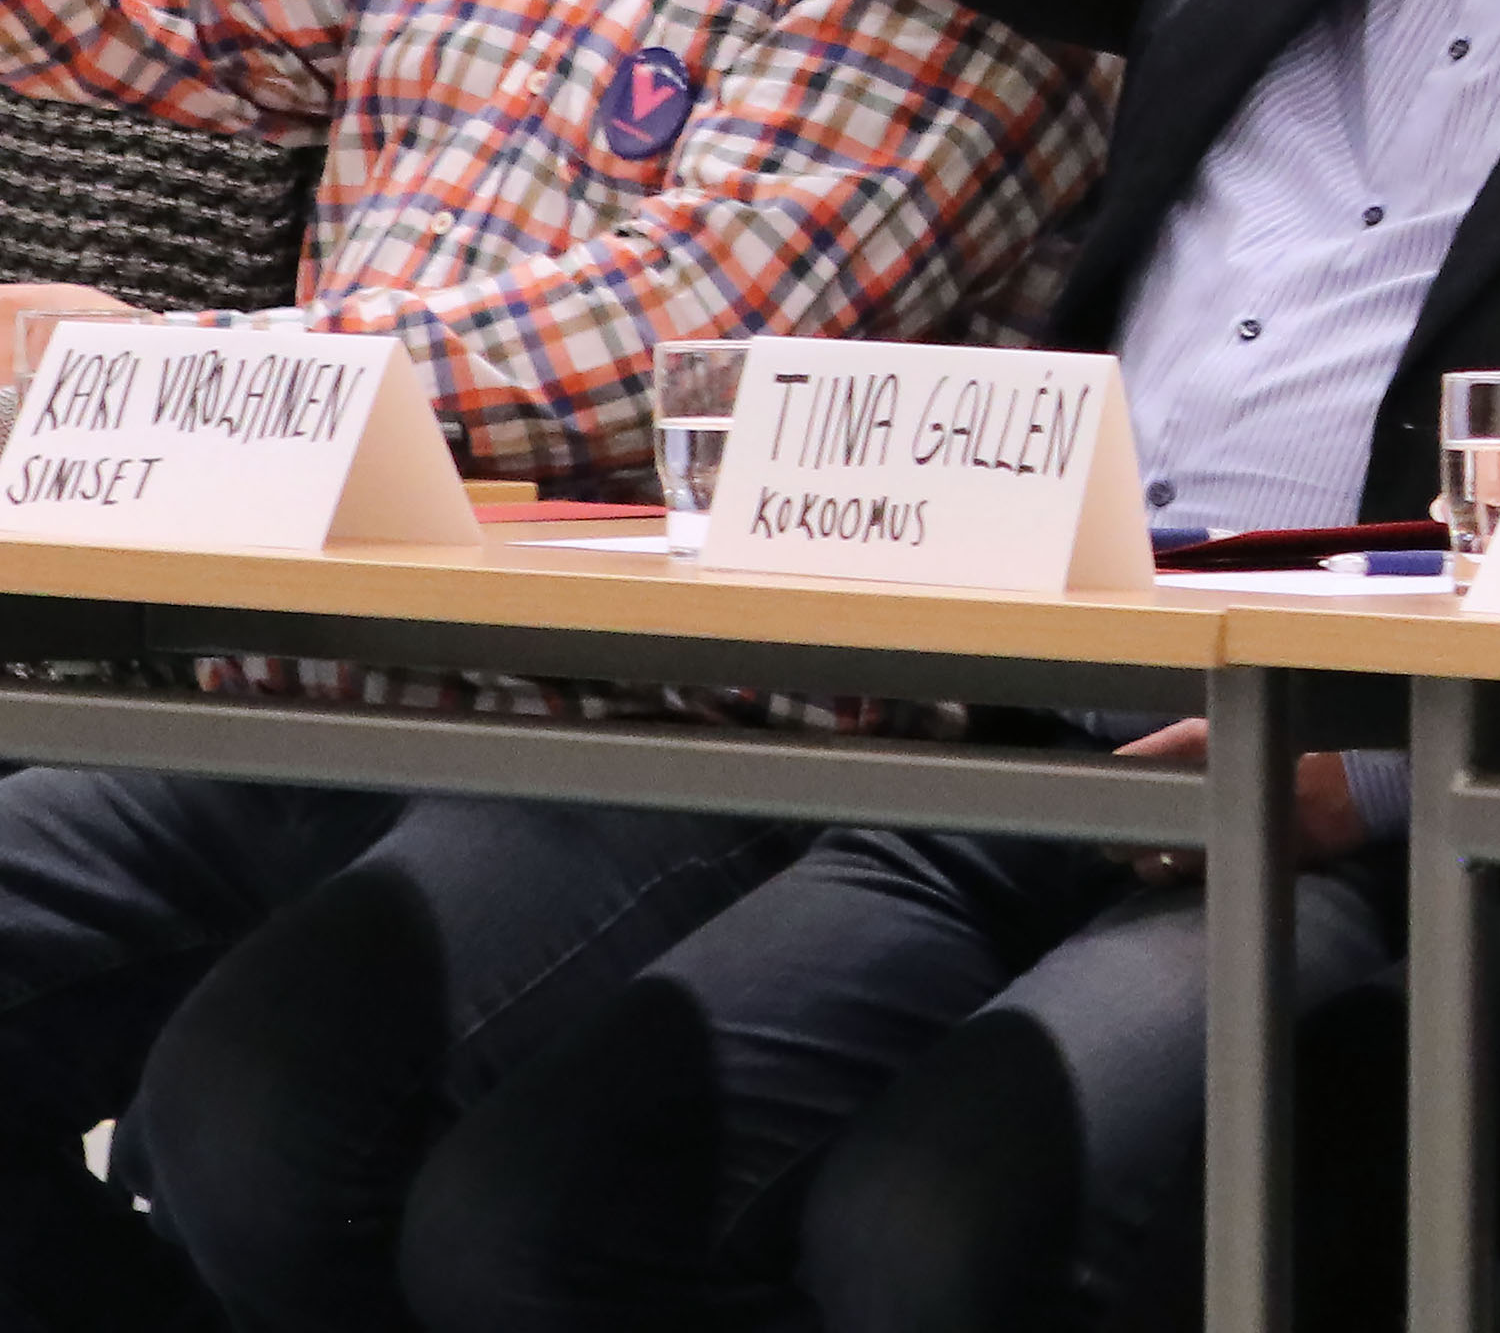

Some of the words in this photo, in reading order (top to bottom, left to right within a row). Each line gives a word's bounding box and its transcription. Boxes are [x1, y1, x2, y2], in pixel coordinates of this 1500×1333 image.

[31, 349, 140, 436] KARI
[151, 349, 365, 443] VIROLAINEN
[771, 374, 898, 469] TIINA
[911, 369, 1090, 478] GALLÉN
[7, 455, 163, 505] SINISET
[751, 486, 928, 546] KOKOOMUS
